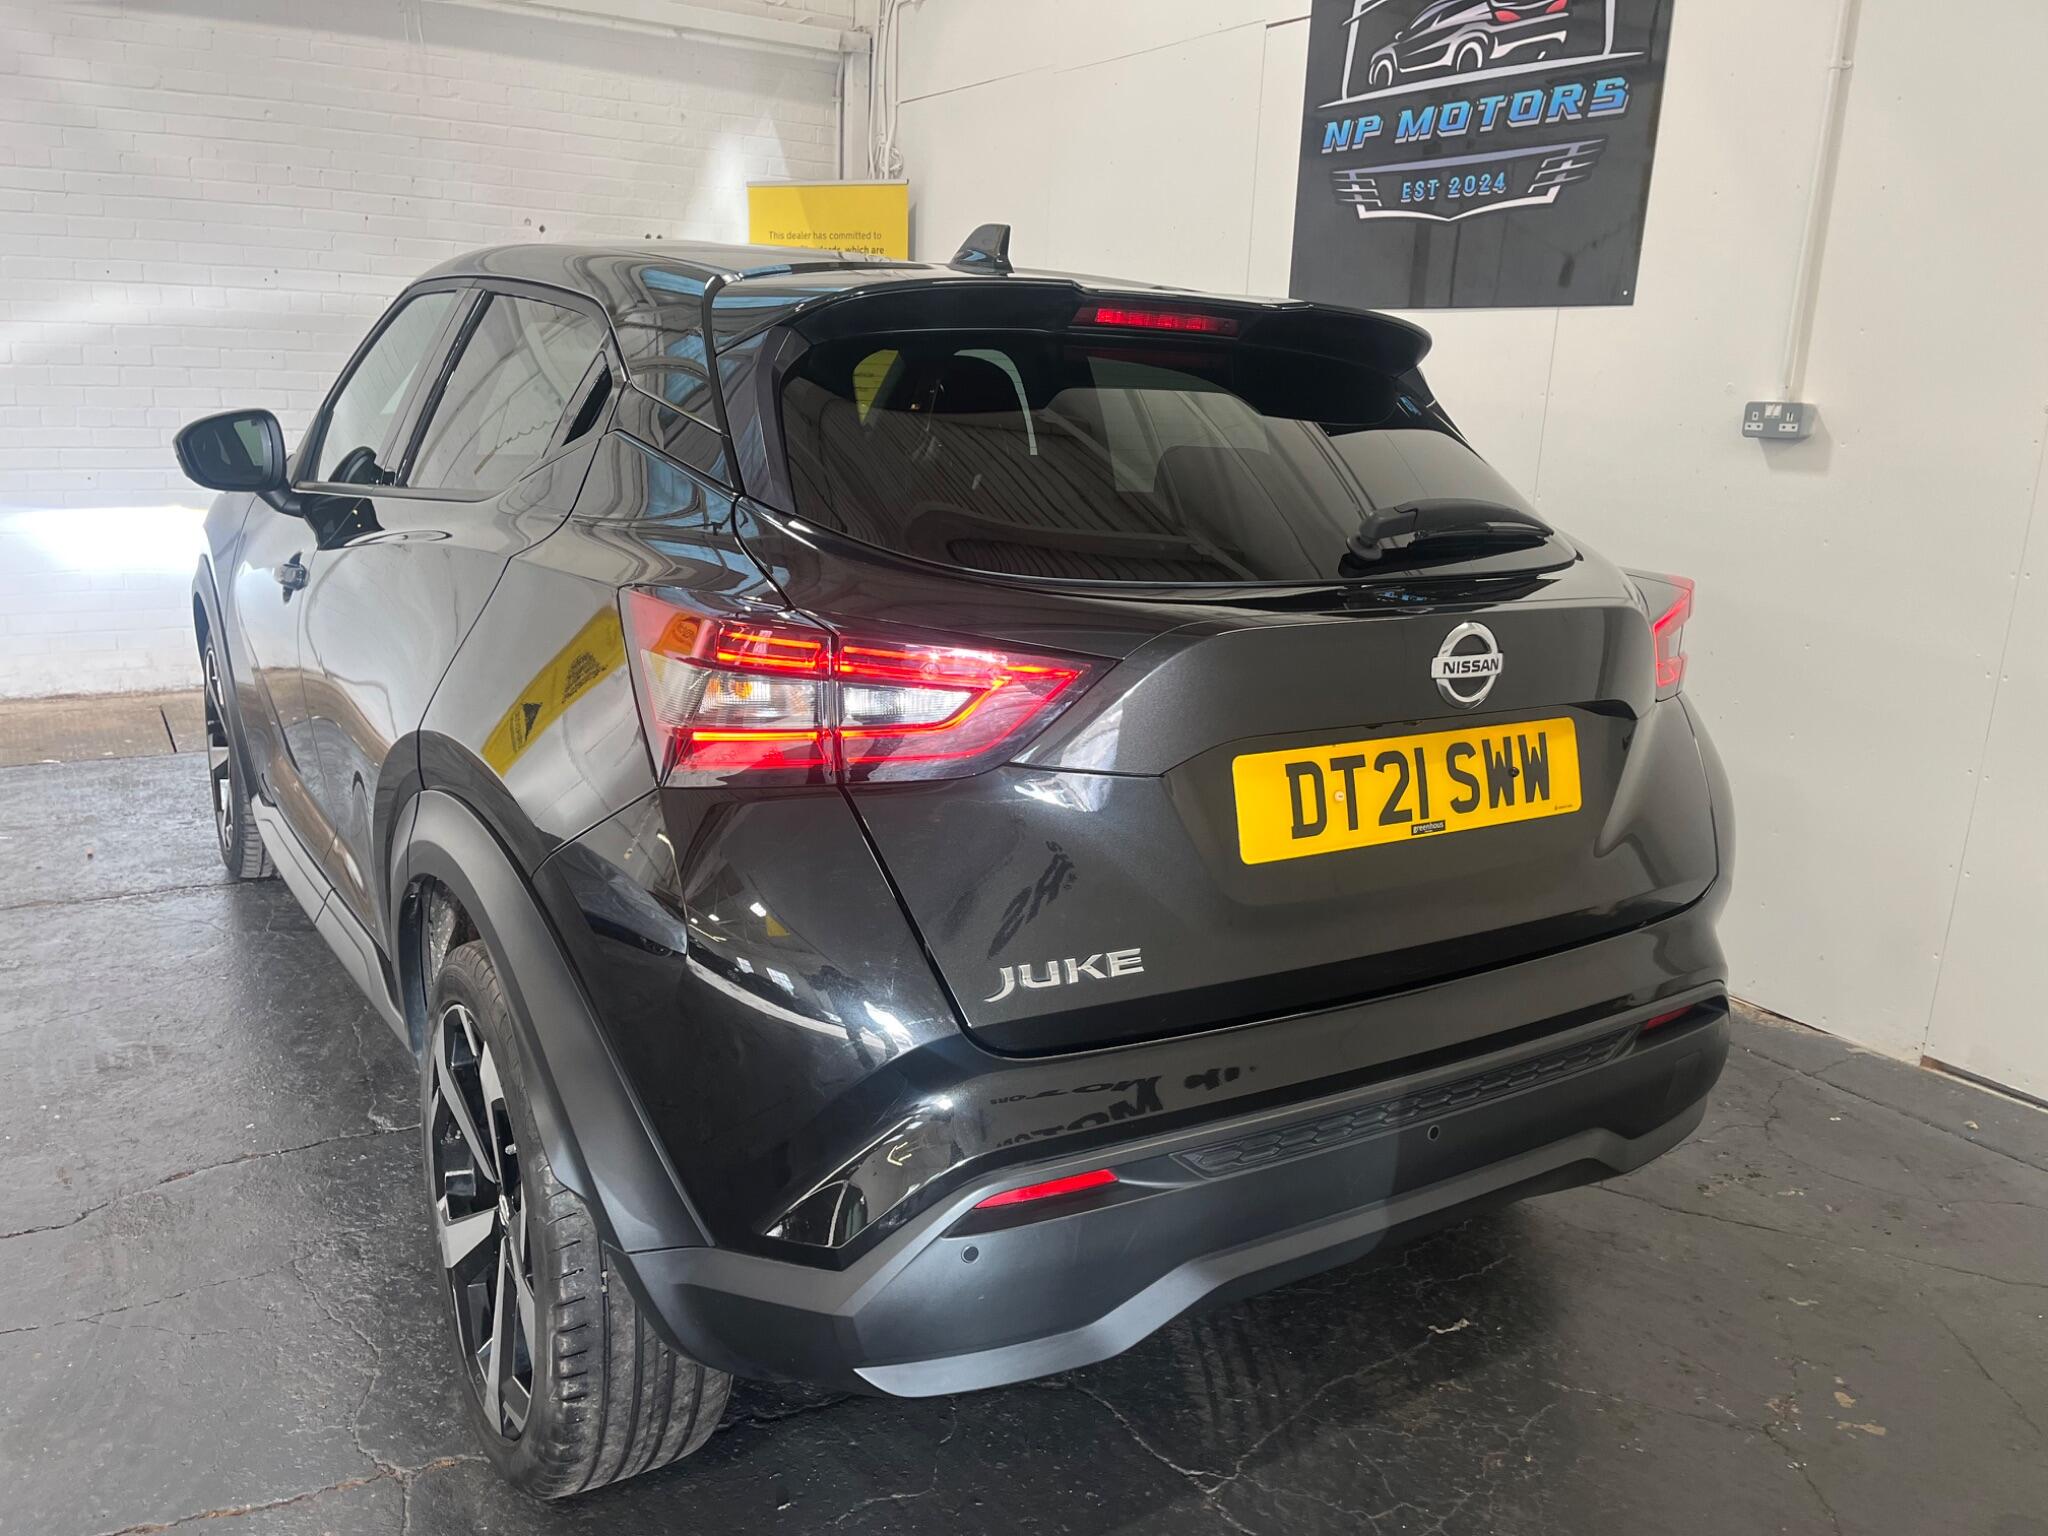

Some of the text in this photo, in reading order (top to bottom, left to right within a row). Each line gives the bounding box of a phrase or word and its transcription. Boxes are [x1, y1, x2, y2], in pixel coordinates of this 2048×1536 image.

[1321, 77, 1630, 154] NP MOTORS
[1400, 171, 1507, 203] EST 2024
[769, 231, 882, 240] This dealer has committed to
[845, 245, 869, 254] which
[871, 247, 885, 255] are
[1442, 657, 1500, 675] NISSAN
[1285, 731, 1551, 840] DT21 SWW
[983, 947, 1145, 1003] JUKE
